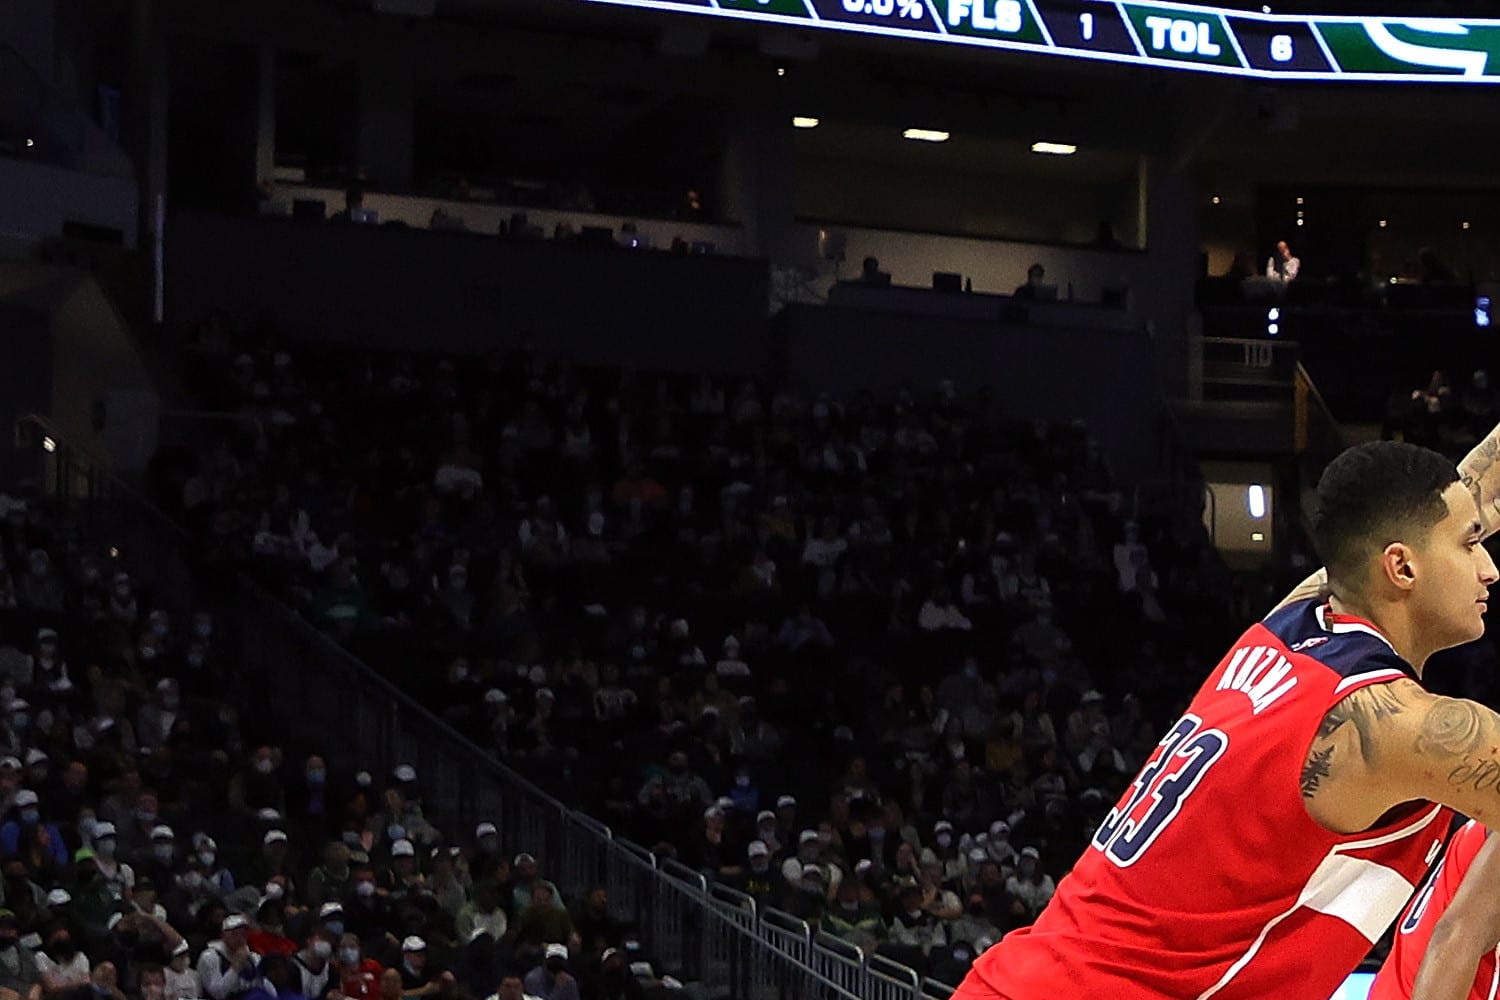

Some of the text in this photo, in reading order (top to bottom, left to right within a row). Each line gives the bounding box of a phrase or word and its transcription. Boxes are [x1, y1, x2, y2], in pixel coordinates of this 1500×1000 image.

[1079, 13, 1093, 40] 1
[1146, 16, 1221, 56] TOL
[1271, 35, 1292, 61] 6
[1091, 713, 1229, 868] 33
